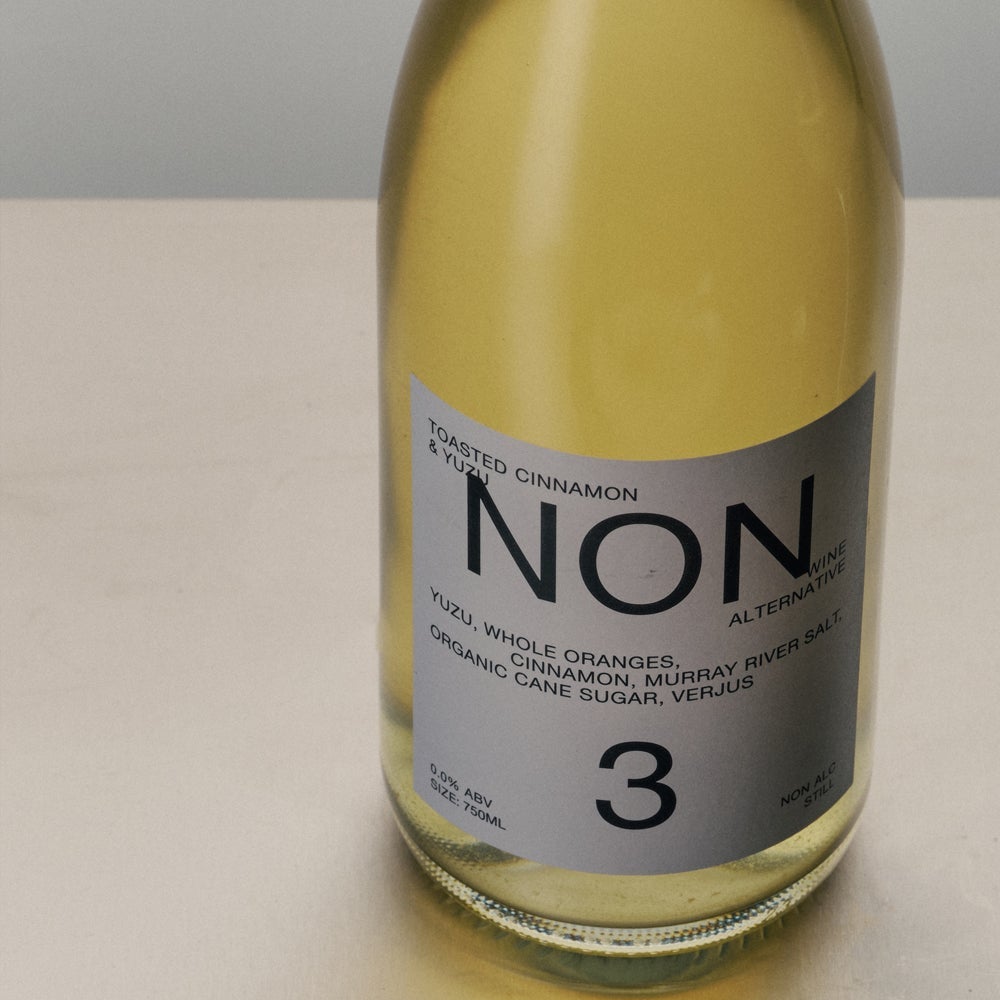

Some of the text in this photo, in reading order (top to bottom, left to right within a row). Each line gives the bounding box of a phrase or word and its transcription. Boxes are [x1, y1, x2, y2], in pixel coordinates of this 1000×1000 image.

[428, 417, 638, 502] TOASTED CINNAMON
[429, 438, 489, 486] & YUZU
[467, 473, 815, 616] NON
[807, 538, 847, 578] WINE
[430, 586, 680, 670] YUZU, WHOLE ORANGES,
[728, 557, 846, 628] ALTERNATIVE
[430, 624, 754, 706] ORGANIC CANE SUGAR, VERJUS
[510, 608, 842, 689] CINNAMON, MURRAY RIVER SALT,
[430, 763, 493, 809] 0.0% ABV
[430, 778, 507, 831] SIZE: 750ML
[595, 741, 677, 830] 3
[780, 761, 837, 807] NON ALC
[804, 780, 835, 808] STILL
